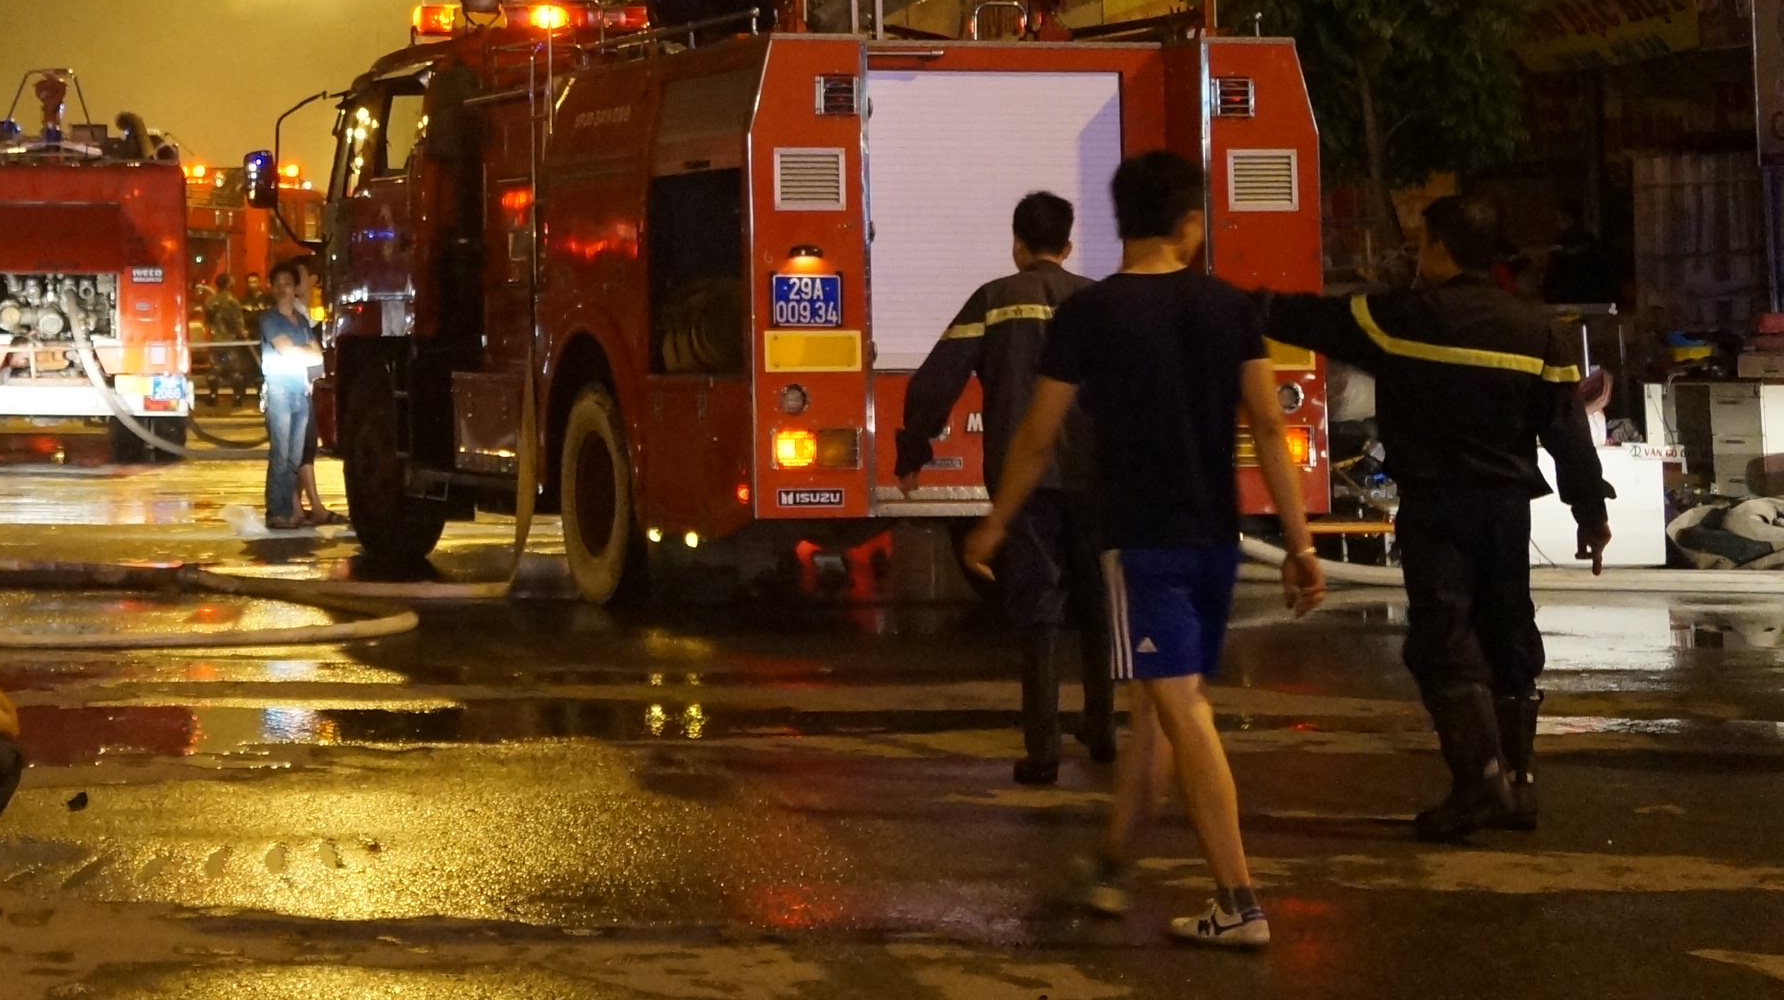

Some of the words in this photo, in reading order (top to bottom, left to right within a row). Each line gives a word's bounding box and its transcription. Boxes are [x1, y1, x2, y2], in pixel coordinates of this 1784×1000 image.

[789, 278, 824, 300] 29A
[776, 301, 838, 324] 009.34
[796, 492, 840, 503] ISUZU
